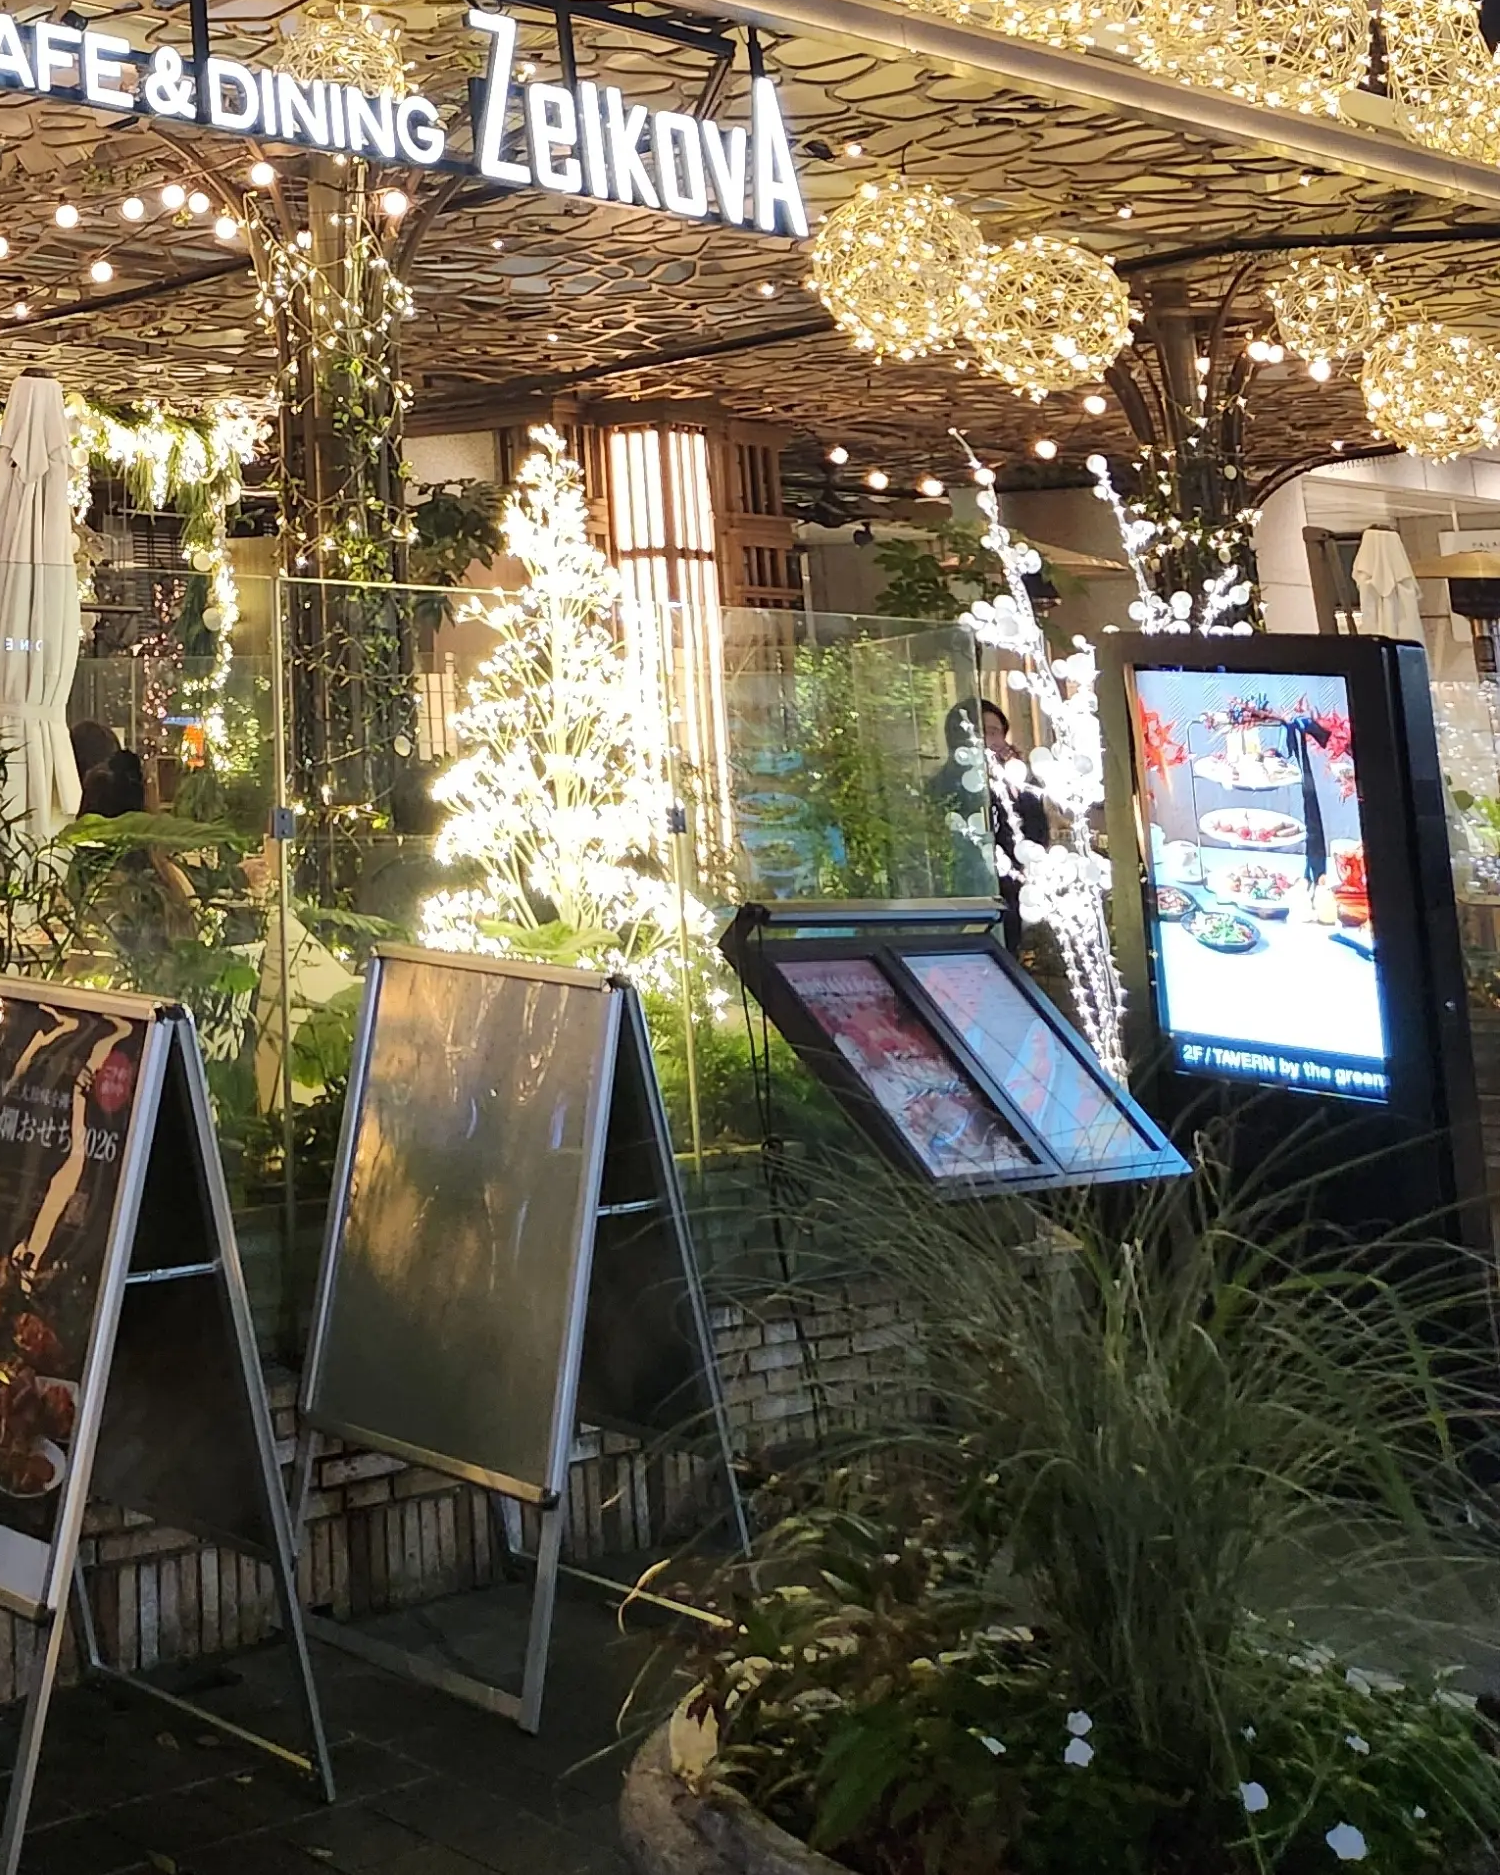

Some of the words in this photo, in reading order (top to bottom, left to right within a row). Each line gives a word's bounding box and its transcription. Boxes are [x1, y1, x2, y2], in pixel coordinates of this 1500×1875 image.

[206, 56, 446, 164] DINING
[1182, 1044, 1204, 1061] 2F
[1212, 1047, 1276, 1072] TAVERN
[1279, 1057, 1299, 1079] by
[1303, 1061, 1331, 1079] the
